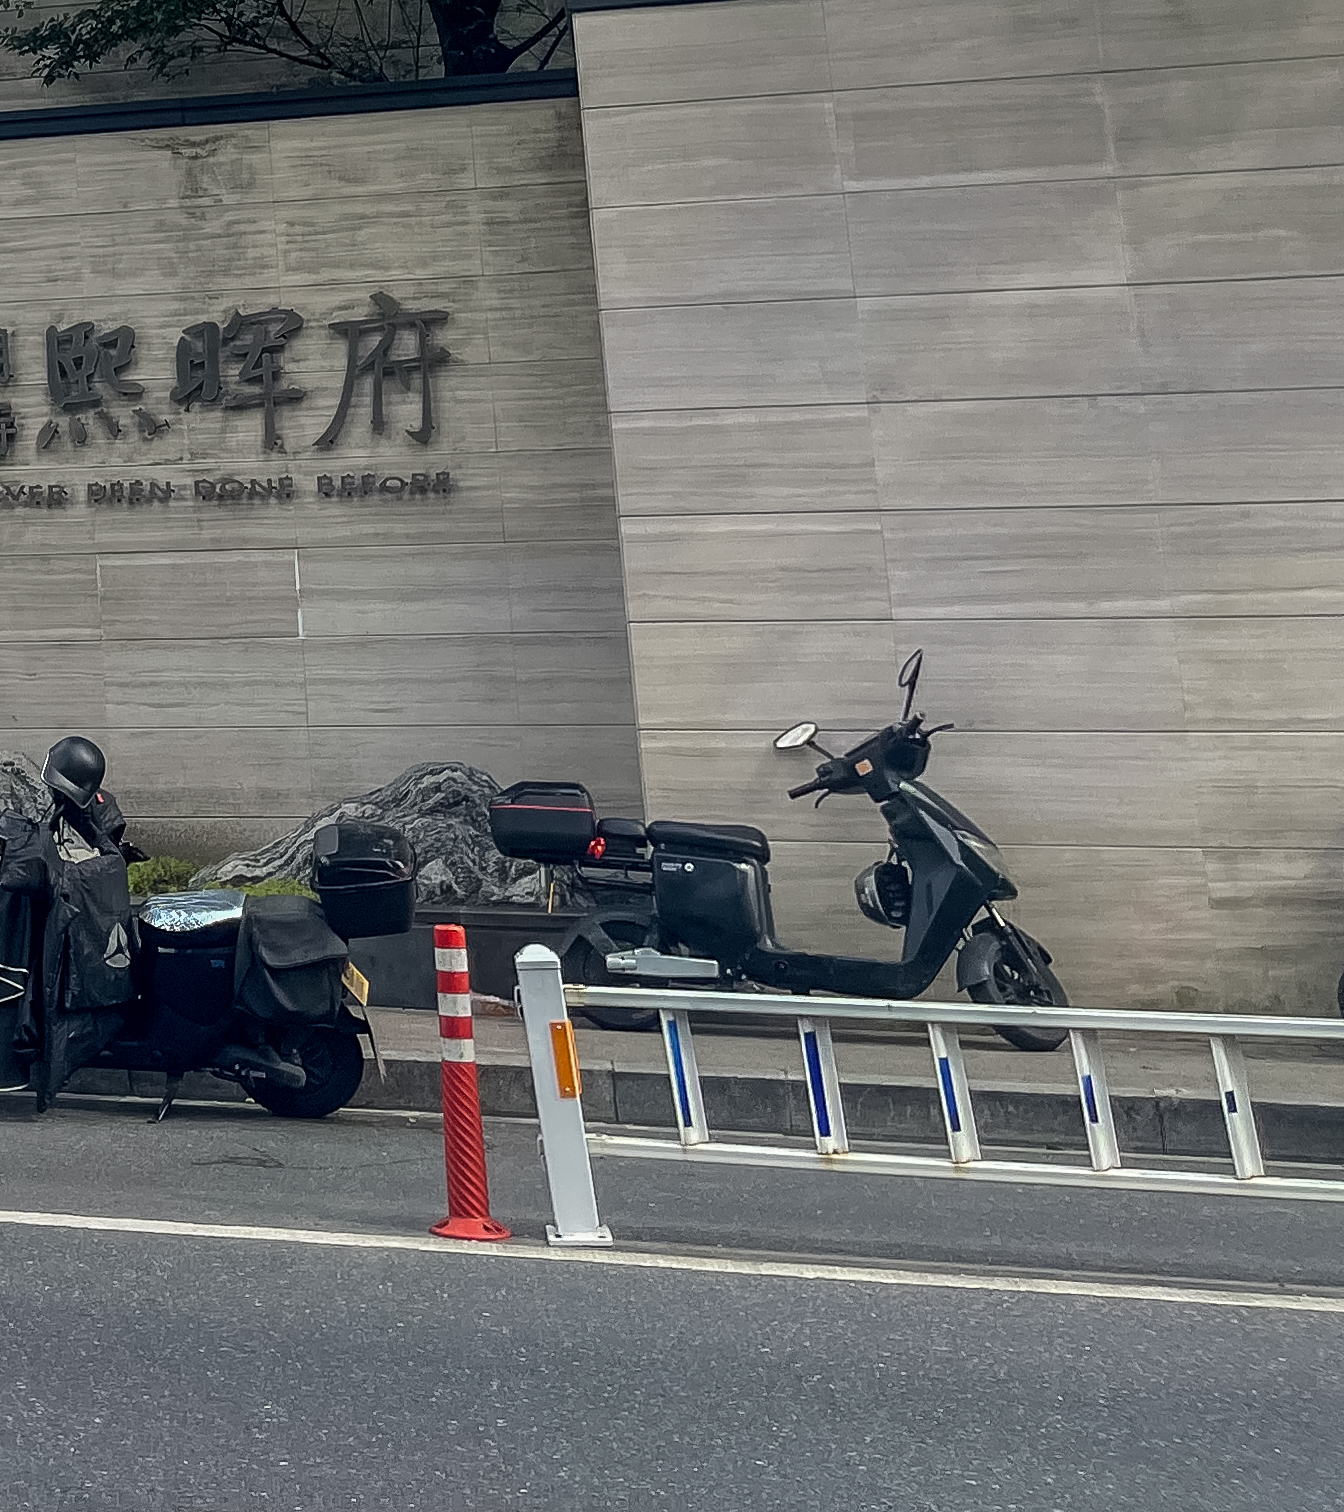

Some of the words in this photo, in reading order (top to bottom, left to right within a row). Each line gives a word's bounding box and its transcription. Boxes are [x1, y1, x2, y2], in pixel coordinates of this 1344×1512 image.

[87, 480, 175, 504] BEEN
[194, 477, 294, 501] DONE
[316, 471, 451, 498] BEFORE
